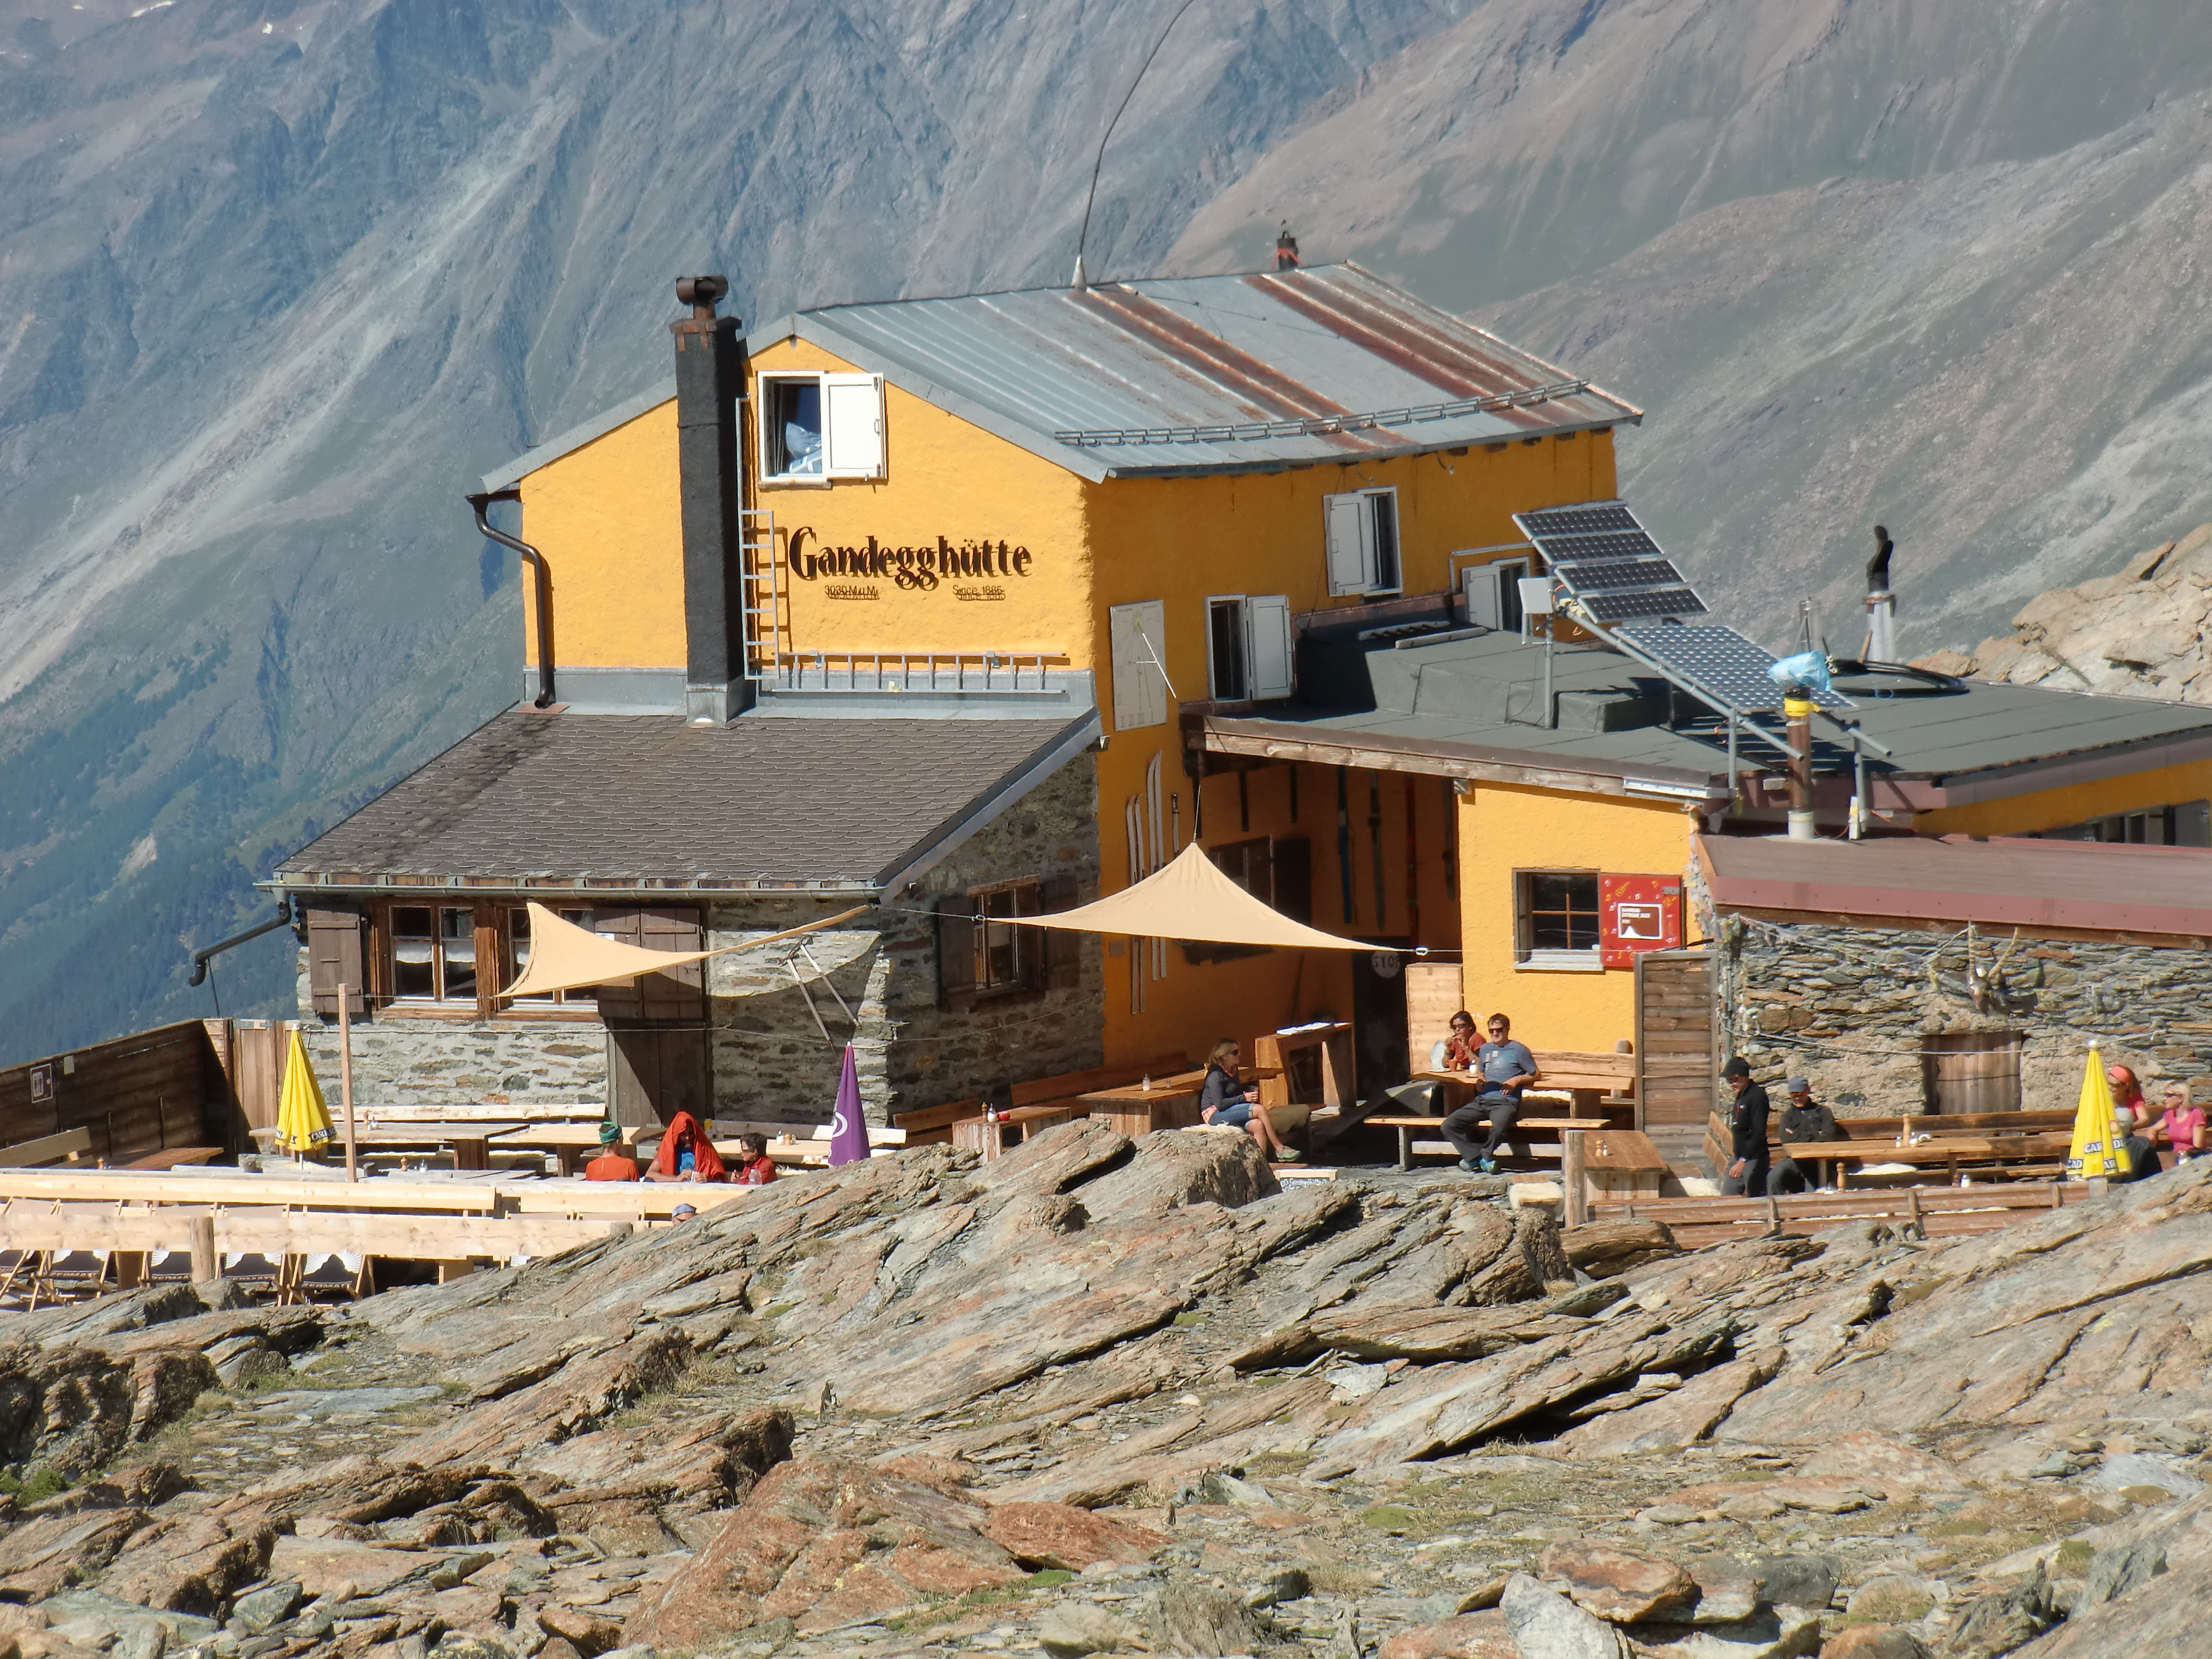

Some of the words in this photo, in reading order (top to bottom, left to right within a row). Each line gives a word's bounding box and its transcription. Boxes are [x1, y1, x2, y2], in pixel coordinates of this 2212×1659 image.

[790, 527, 1032, 591] Gandegghütte
[953, 585, 978, 596] Since
[982, 585, 1002, 596] 1885
